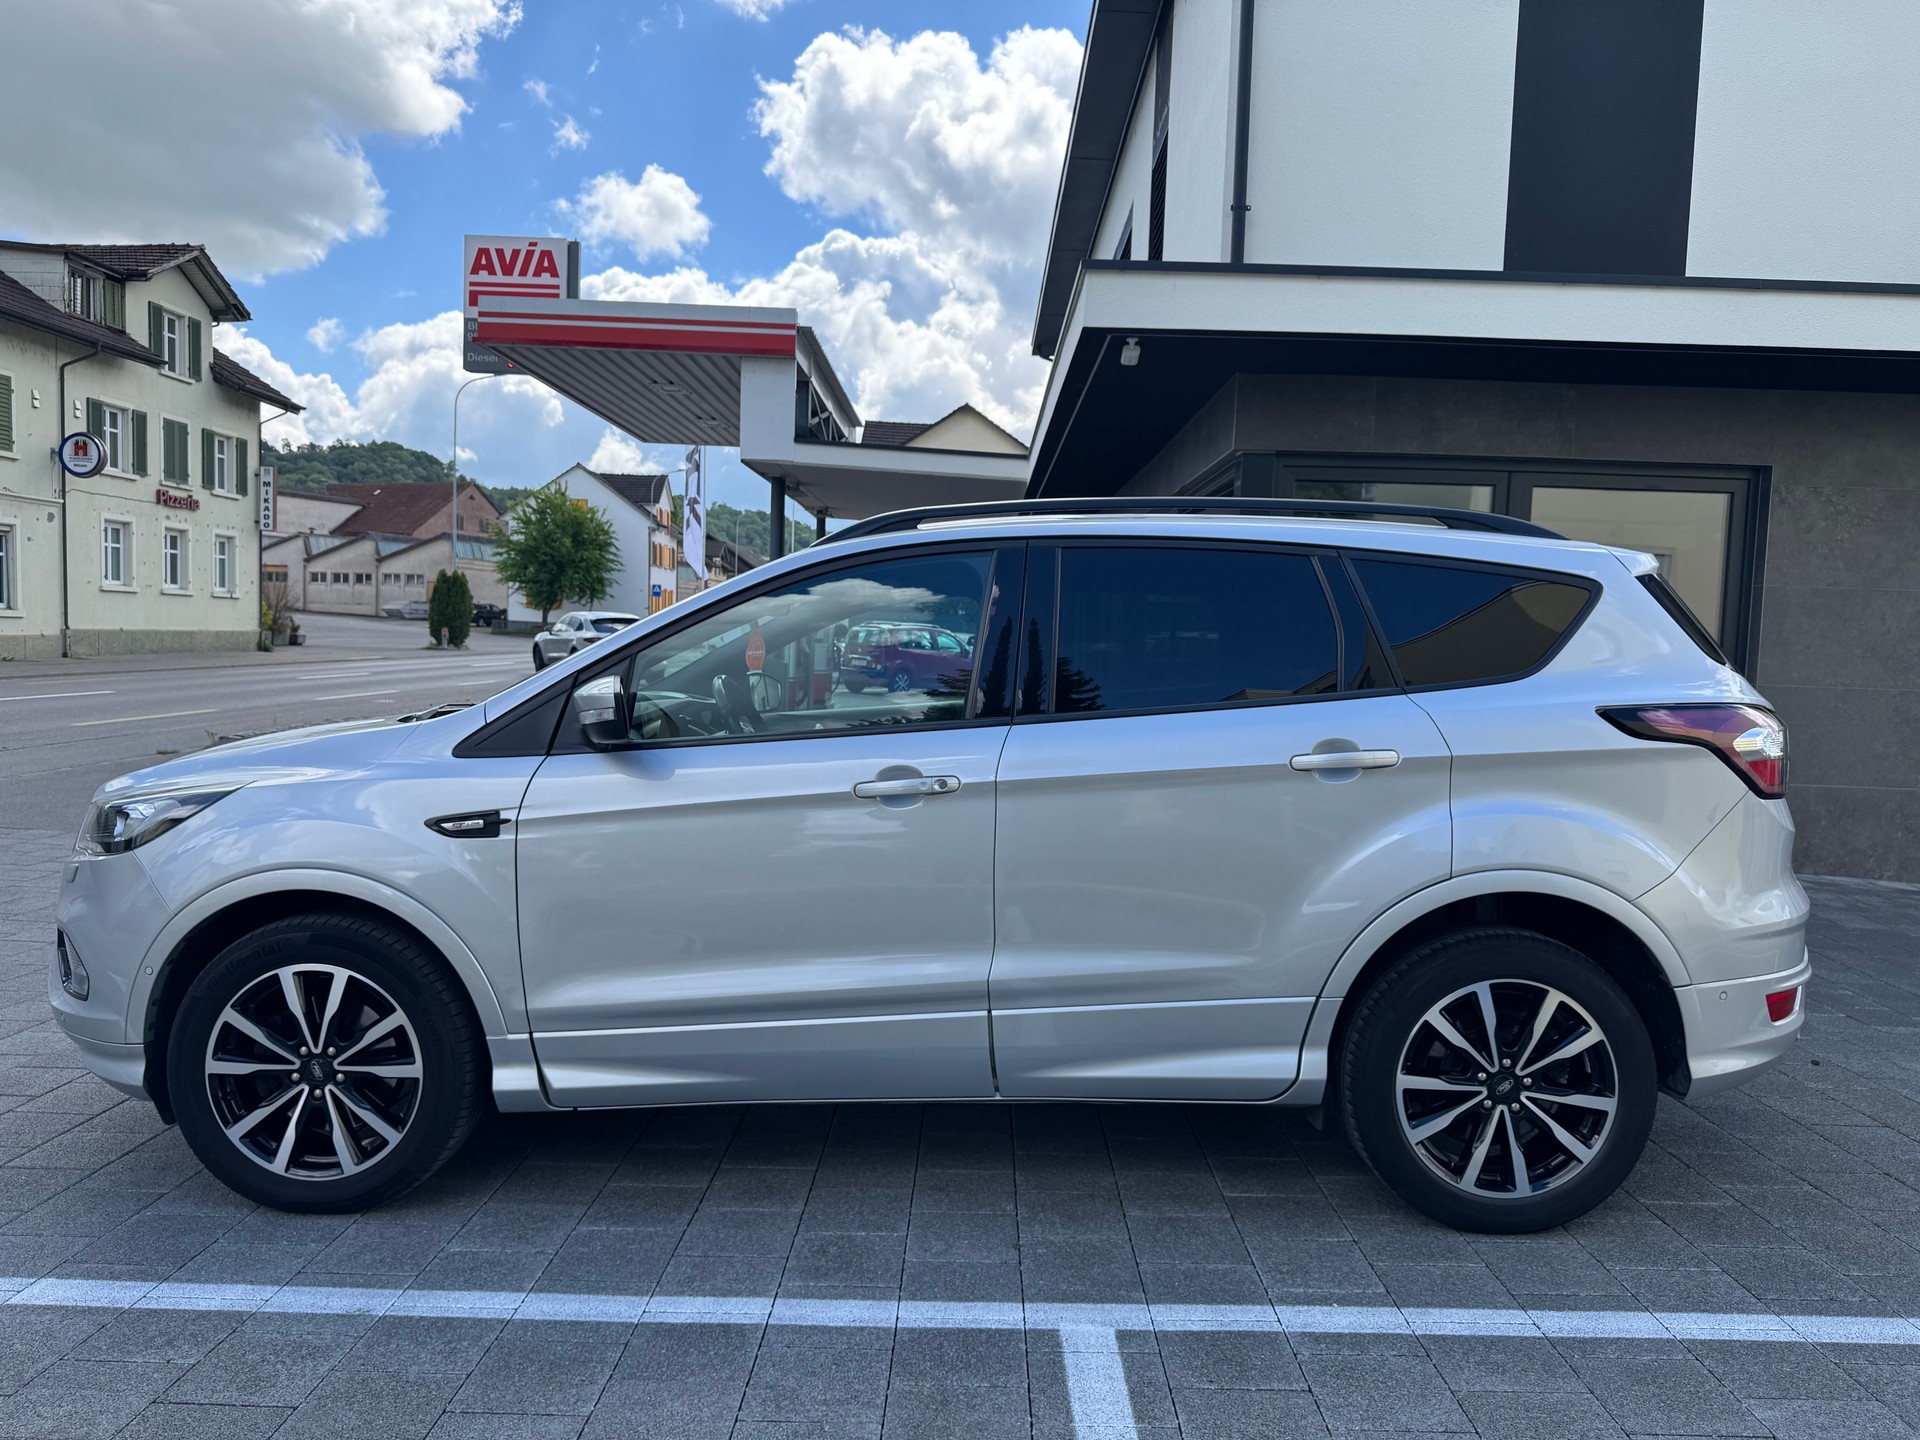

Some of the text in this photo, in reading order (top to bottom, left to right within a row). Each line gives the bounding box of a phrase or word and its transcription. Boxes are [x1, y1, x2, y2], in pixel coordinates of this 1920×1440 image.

[467, 352, 498, 362] Diesel
[159, 490, 200, 511] Pizzeria
[262, 481, 271, 529] MIKADO
